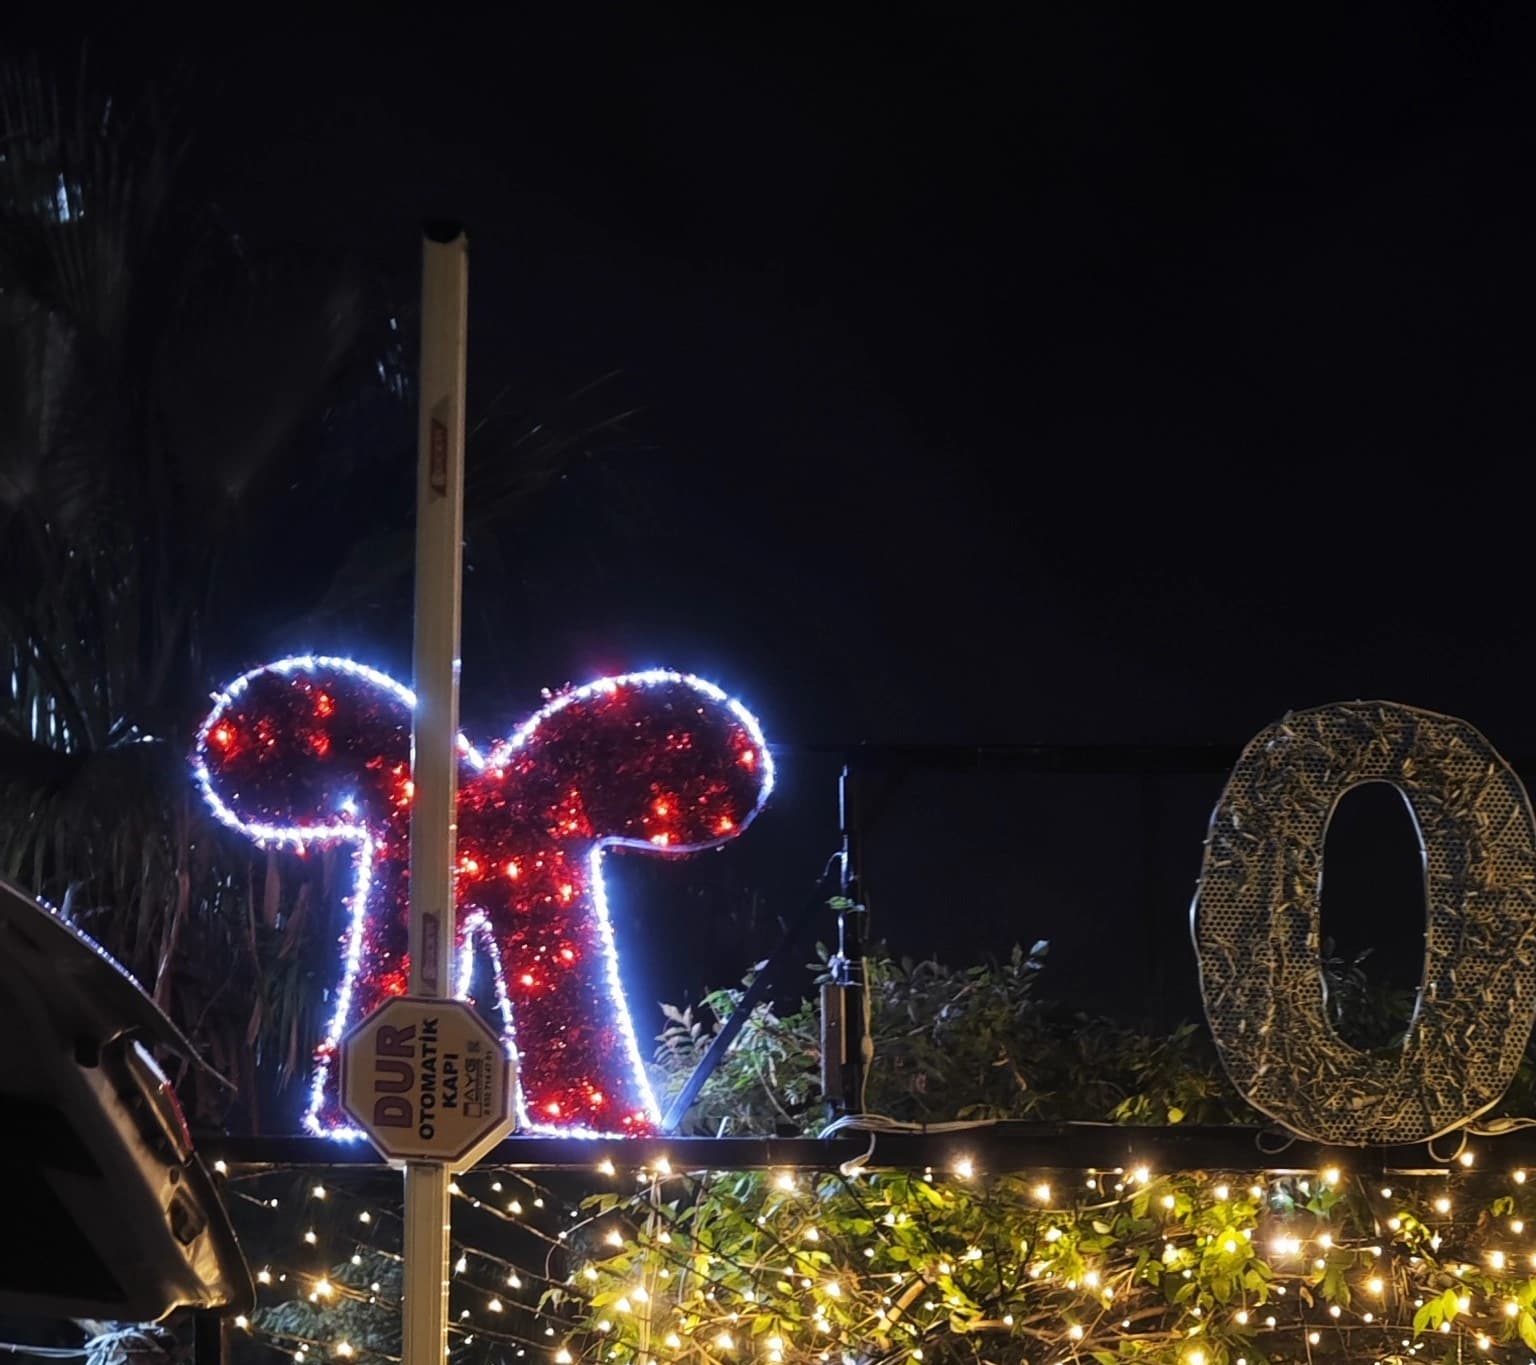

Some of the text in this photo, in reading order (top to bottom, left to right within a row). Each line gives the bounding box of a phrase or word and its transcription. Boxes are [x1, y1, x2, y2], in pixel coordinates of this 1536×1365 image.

[374, 1024, 417, 1128] DUR
[419, 1017, 439, 1140] OTOMATİK
[443, 1053, 458, 1108] KAPI
